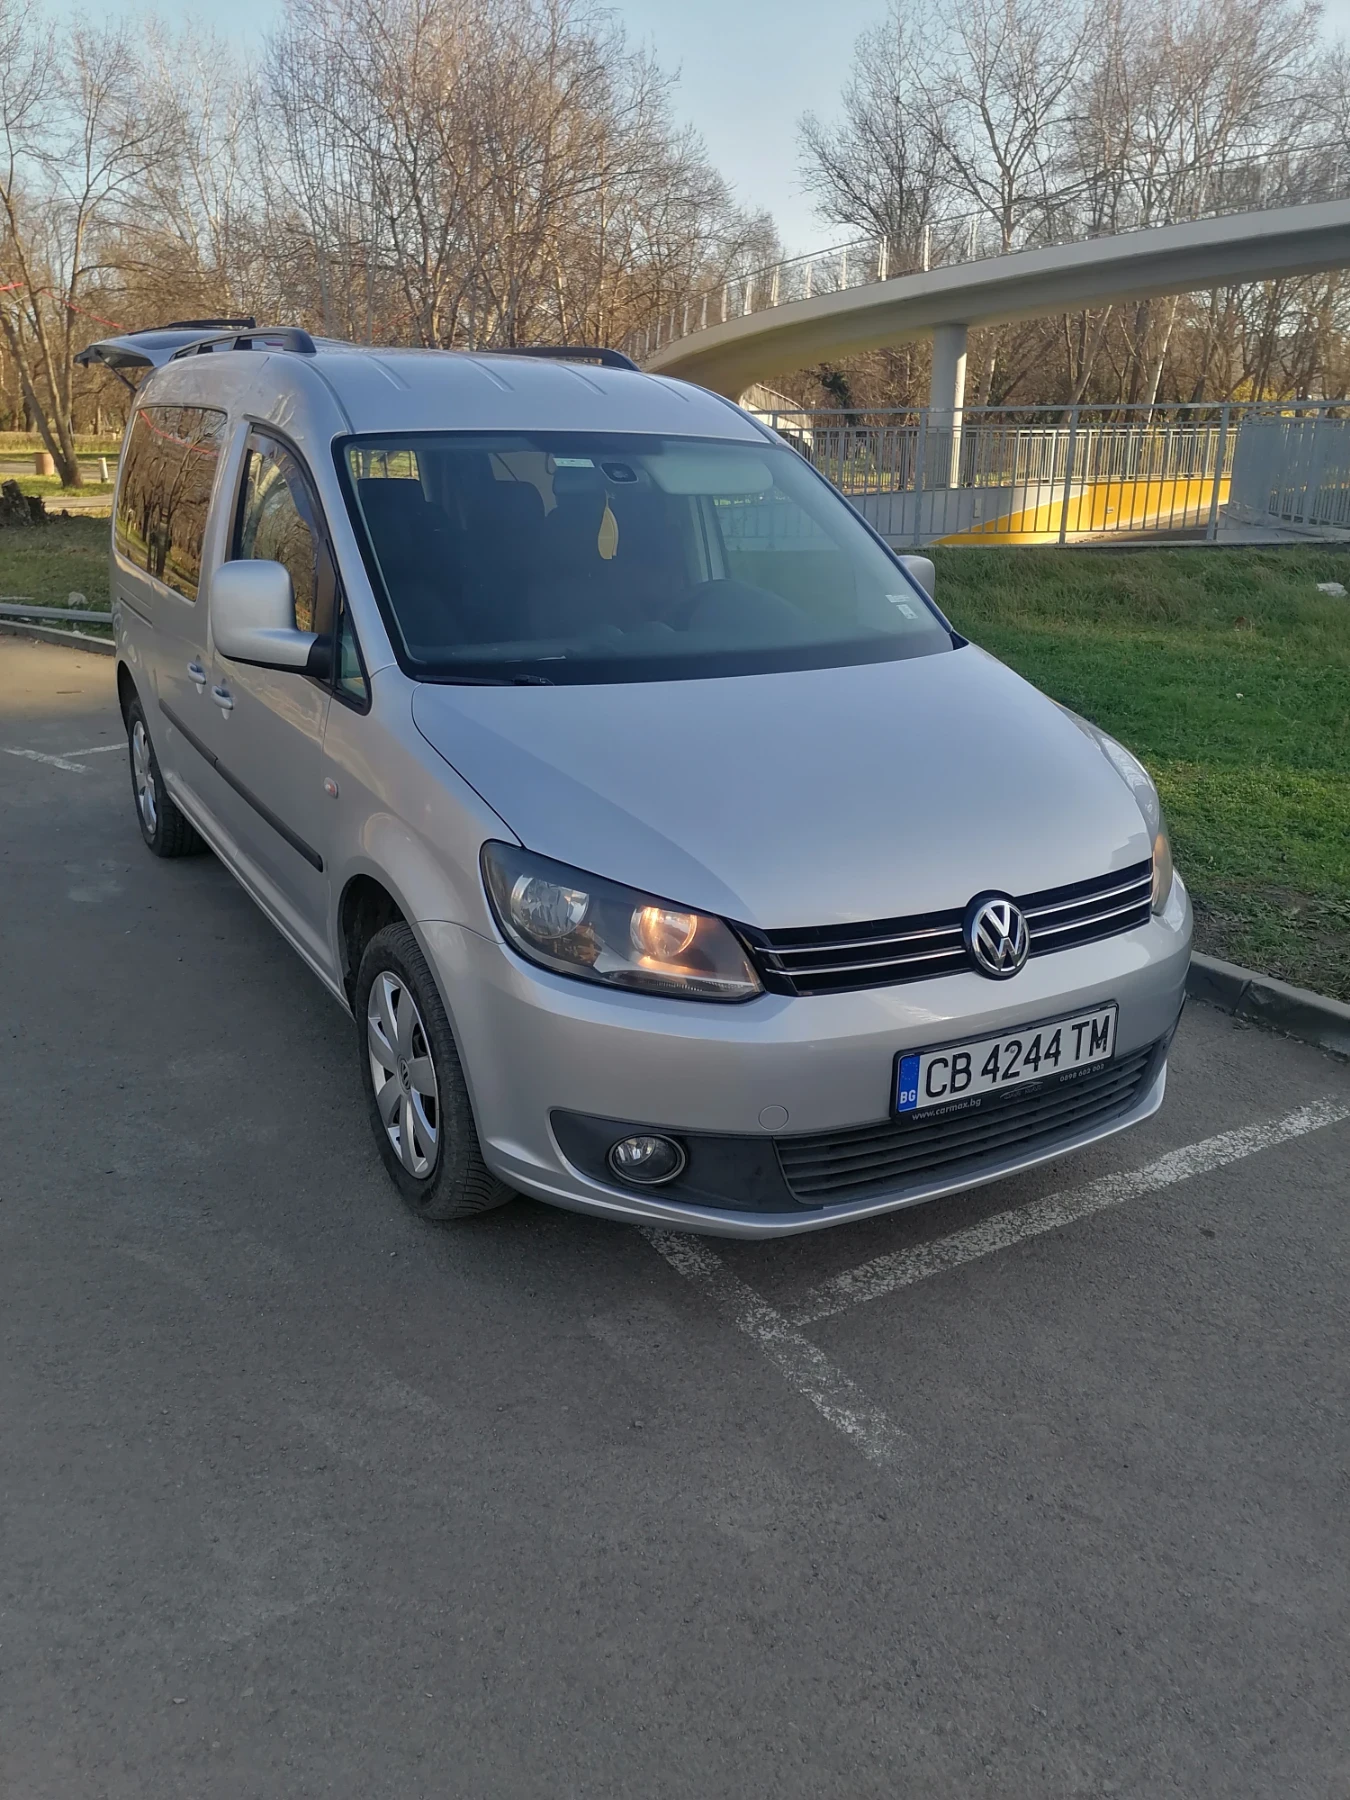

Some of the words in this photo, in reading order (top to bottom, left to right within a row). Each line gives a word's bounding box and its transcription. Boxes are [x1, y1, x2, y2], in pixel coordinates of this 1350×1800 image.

[974, 900, 1025, 974] VW
[926, 1051, 972, 1097] CB
[981, 1028, 1062, 1084] 4244
[1071, 1015, 1110, 1061] TM
[899, 1088, 917, 1105] BG
[912, 1098, 982, 1120] www.carmax.bg
